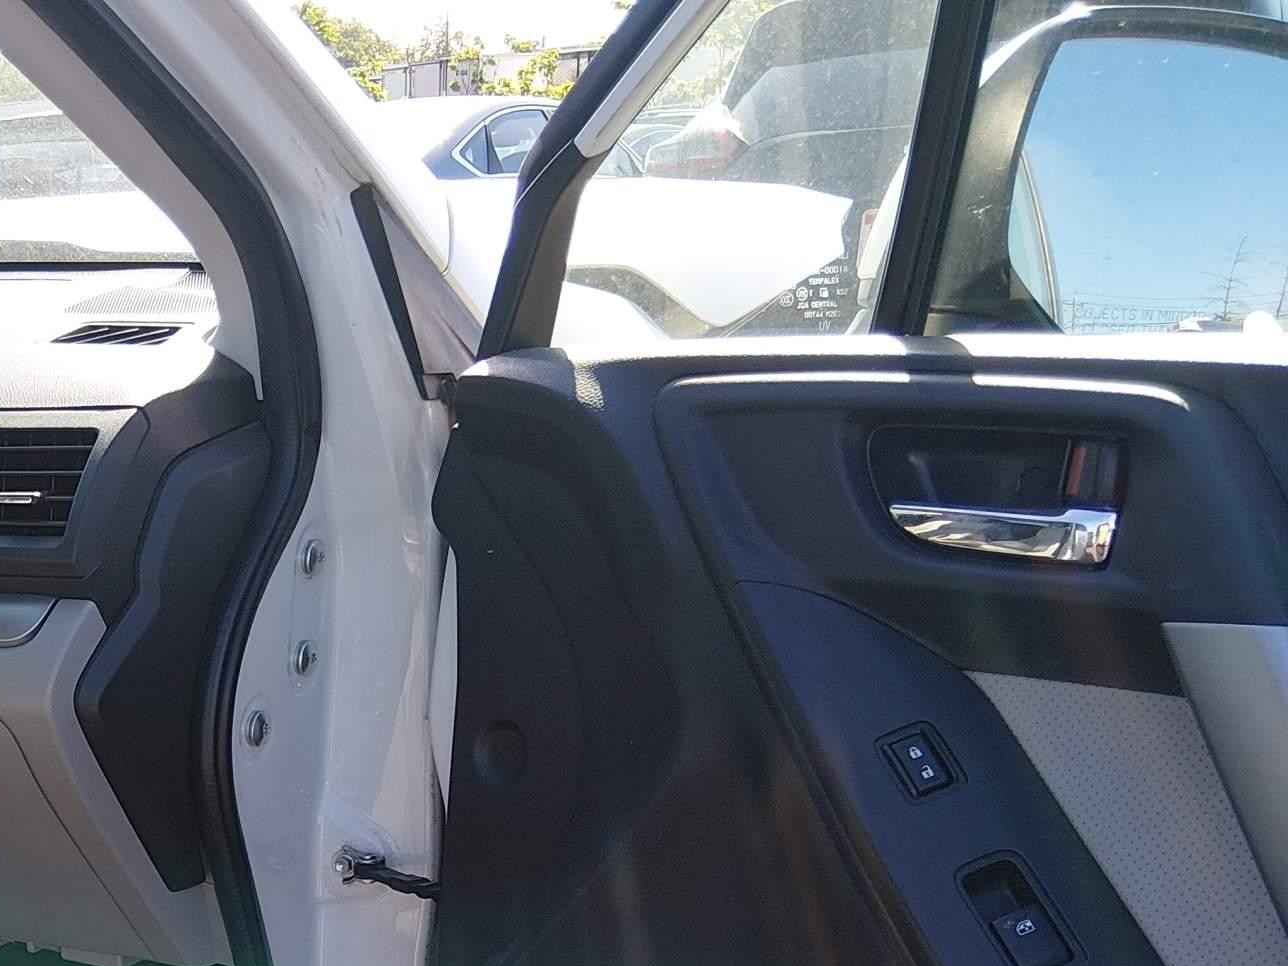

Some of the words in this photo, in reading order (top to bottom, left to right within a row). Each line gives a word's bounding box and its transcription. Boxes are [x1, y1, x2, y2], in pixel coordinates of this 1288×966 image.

[1075, 306, 1137, 321] OBJECTS
[1141, 309, 1153, 321] IN
[818, 321, 831, 331] UV
